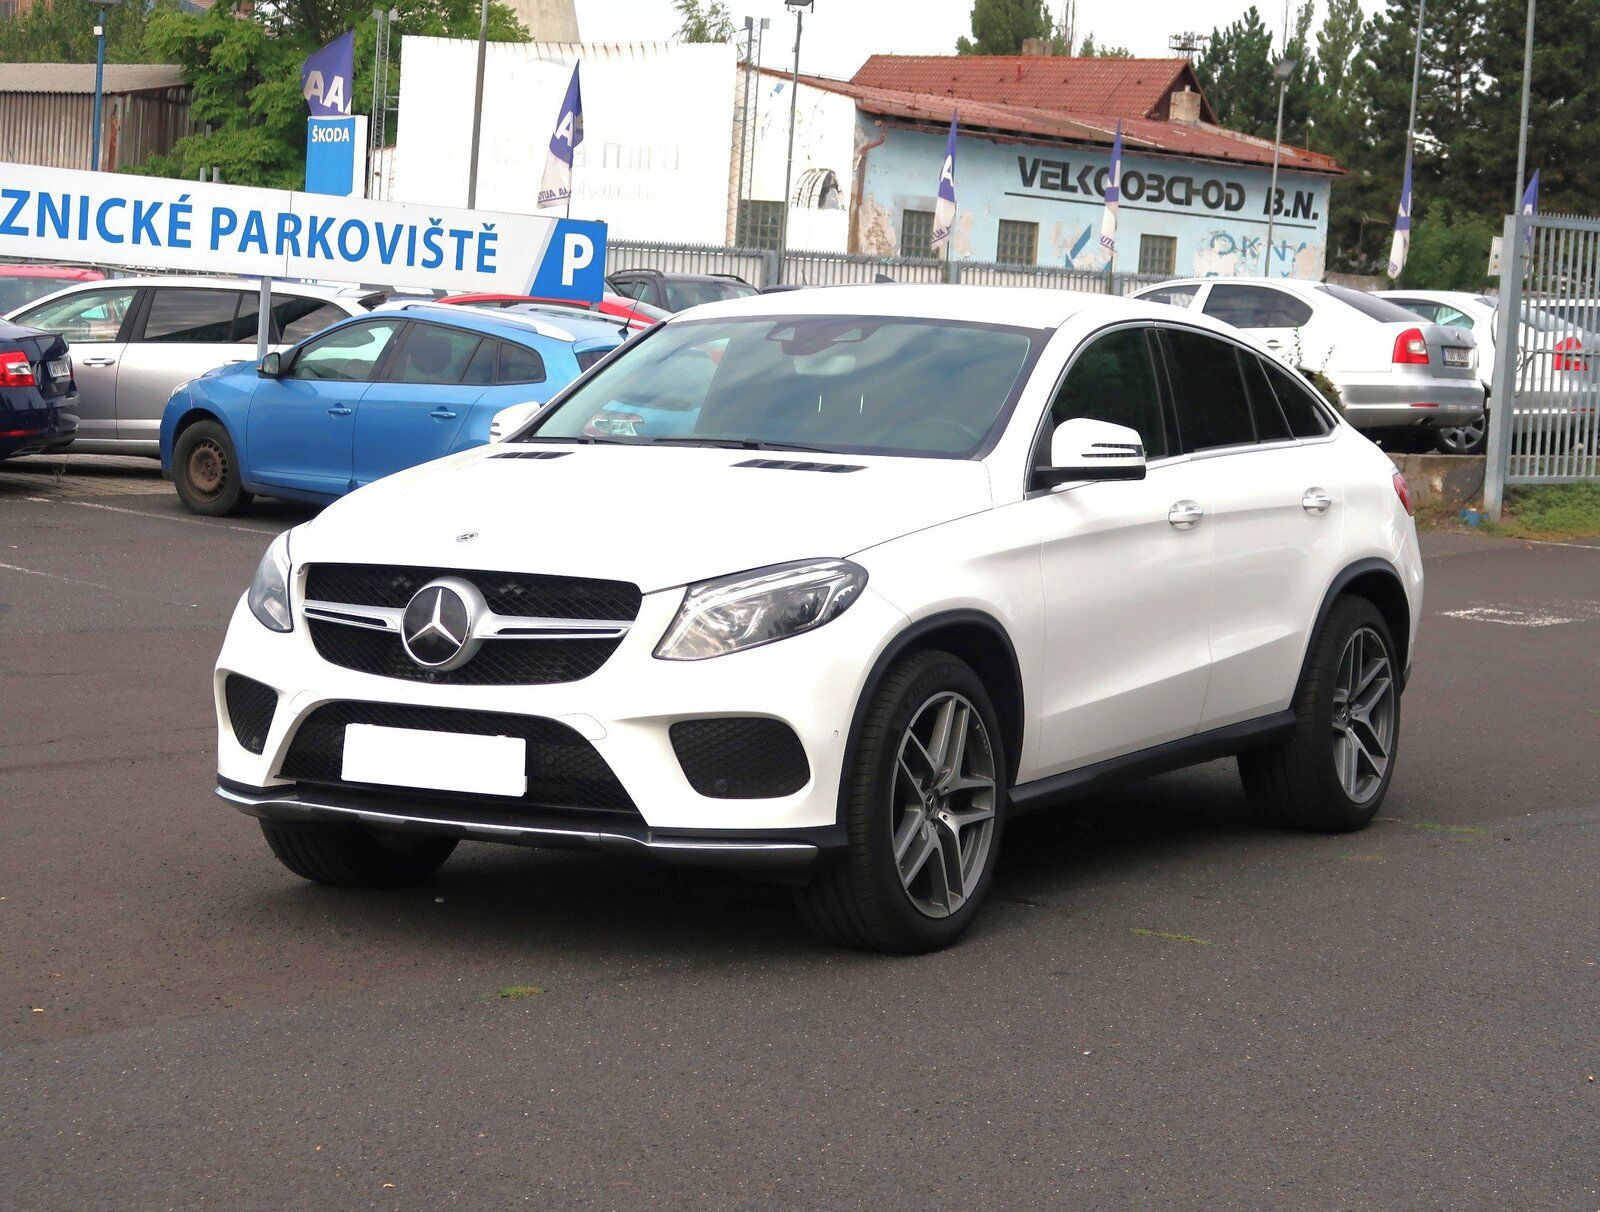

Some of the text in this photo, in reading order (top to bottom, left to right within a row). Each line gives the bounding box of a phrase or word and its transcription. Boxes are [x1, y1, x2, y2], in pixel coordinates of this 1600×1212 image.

[311, 125, 350, 143] ŠKODA
[1017, 155, 1320, 221] VELKOOBCHOD B.N.
[0, 188, 594, 286] ZNICKÉ PARKOVIŠTĚ P
